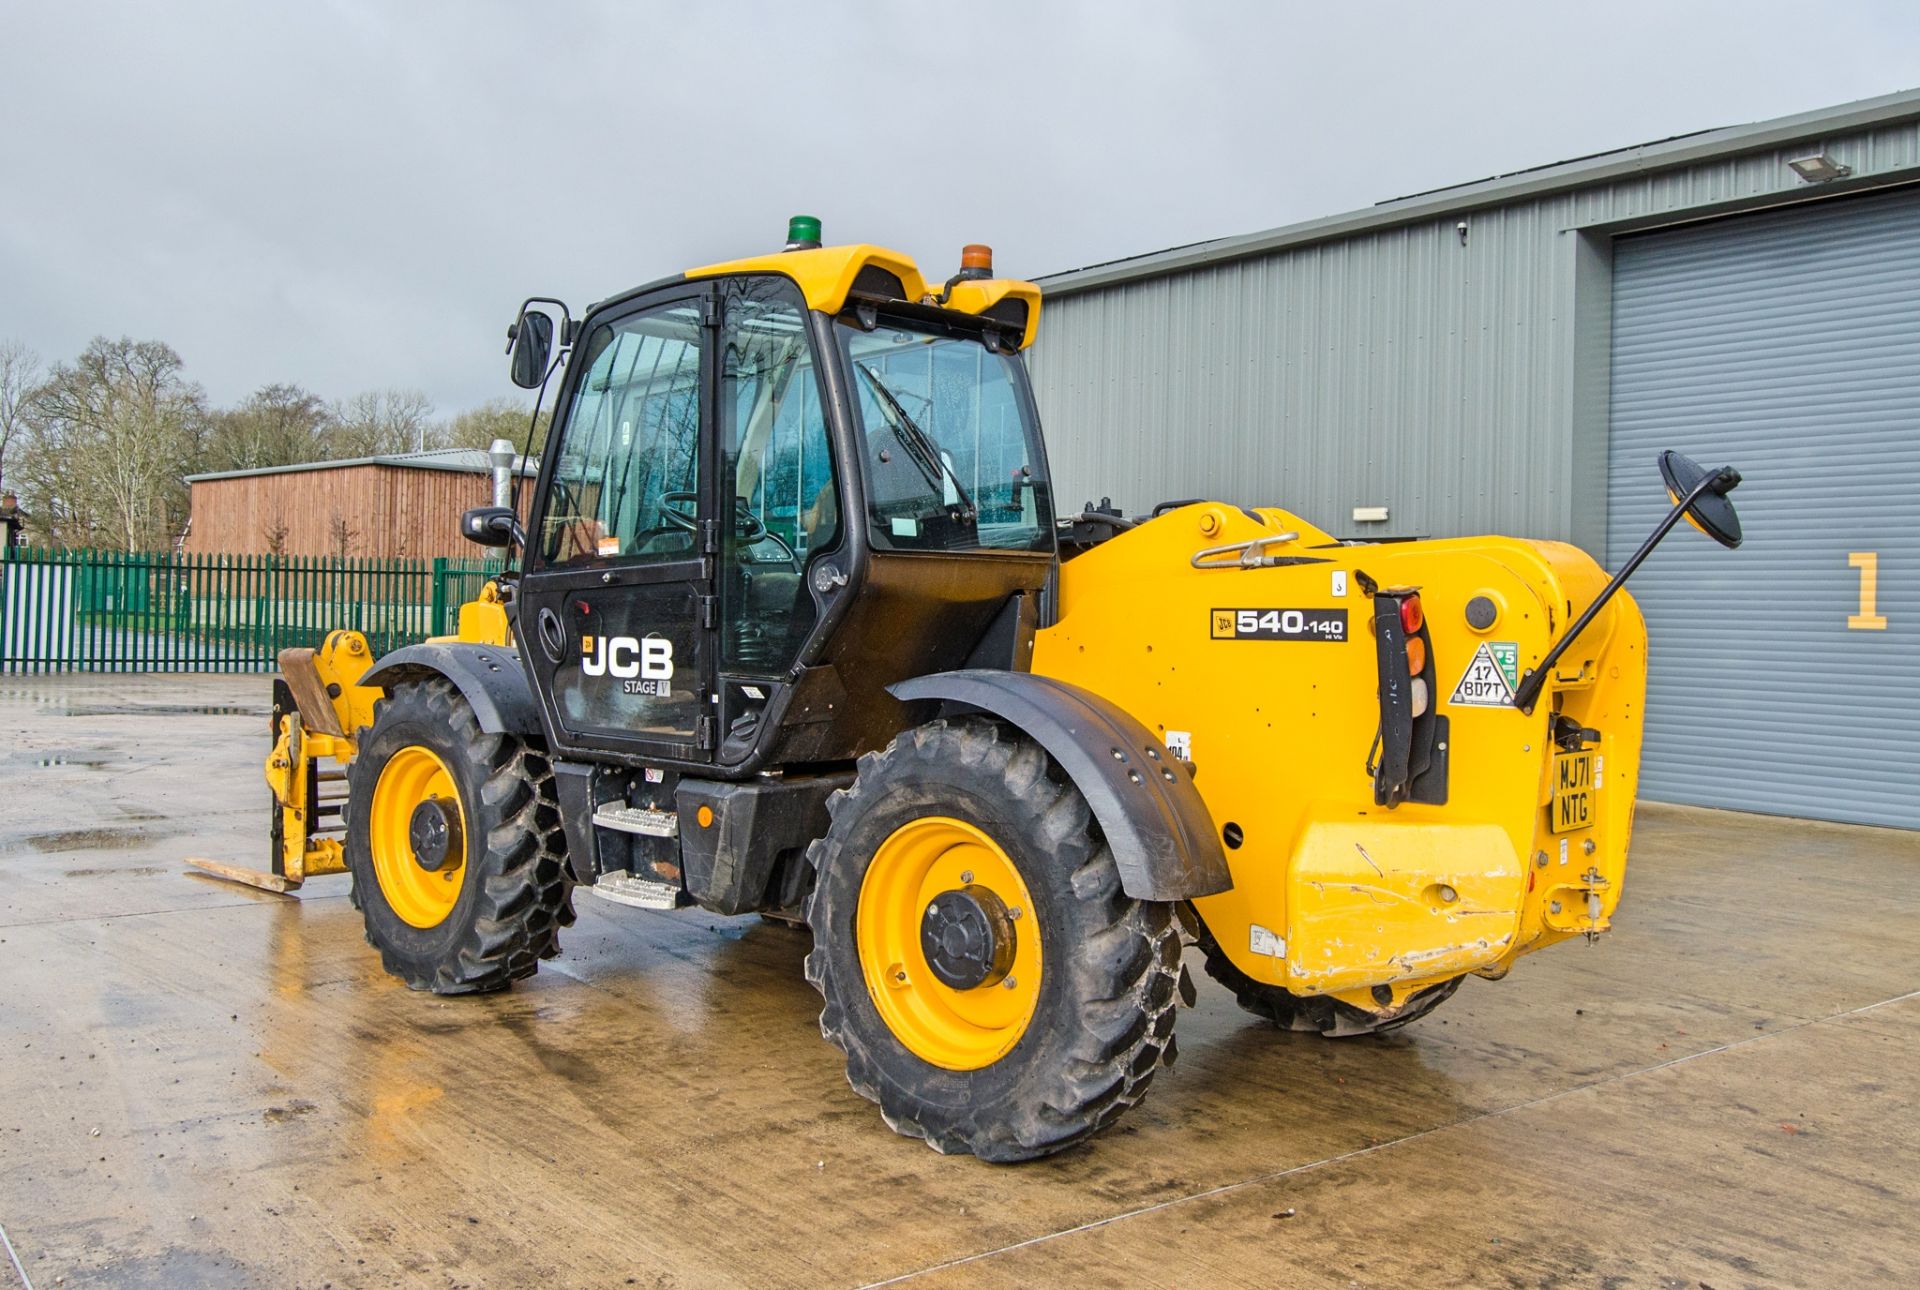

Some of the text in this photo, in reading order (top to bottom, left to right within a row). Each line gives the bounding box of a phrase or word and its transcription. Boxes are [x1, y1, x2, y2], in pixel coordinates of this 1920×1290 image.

[1847, 552, 1887, 630] 1
[1218, 610, 1343, 634] JCB 540-140
[582, 636, 674, 680] JCB
[624, 680, 656, 694] STAGE
[1475, 666, 1492, 681] 17
[1561, 792, 1588, 826] NTG
